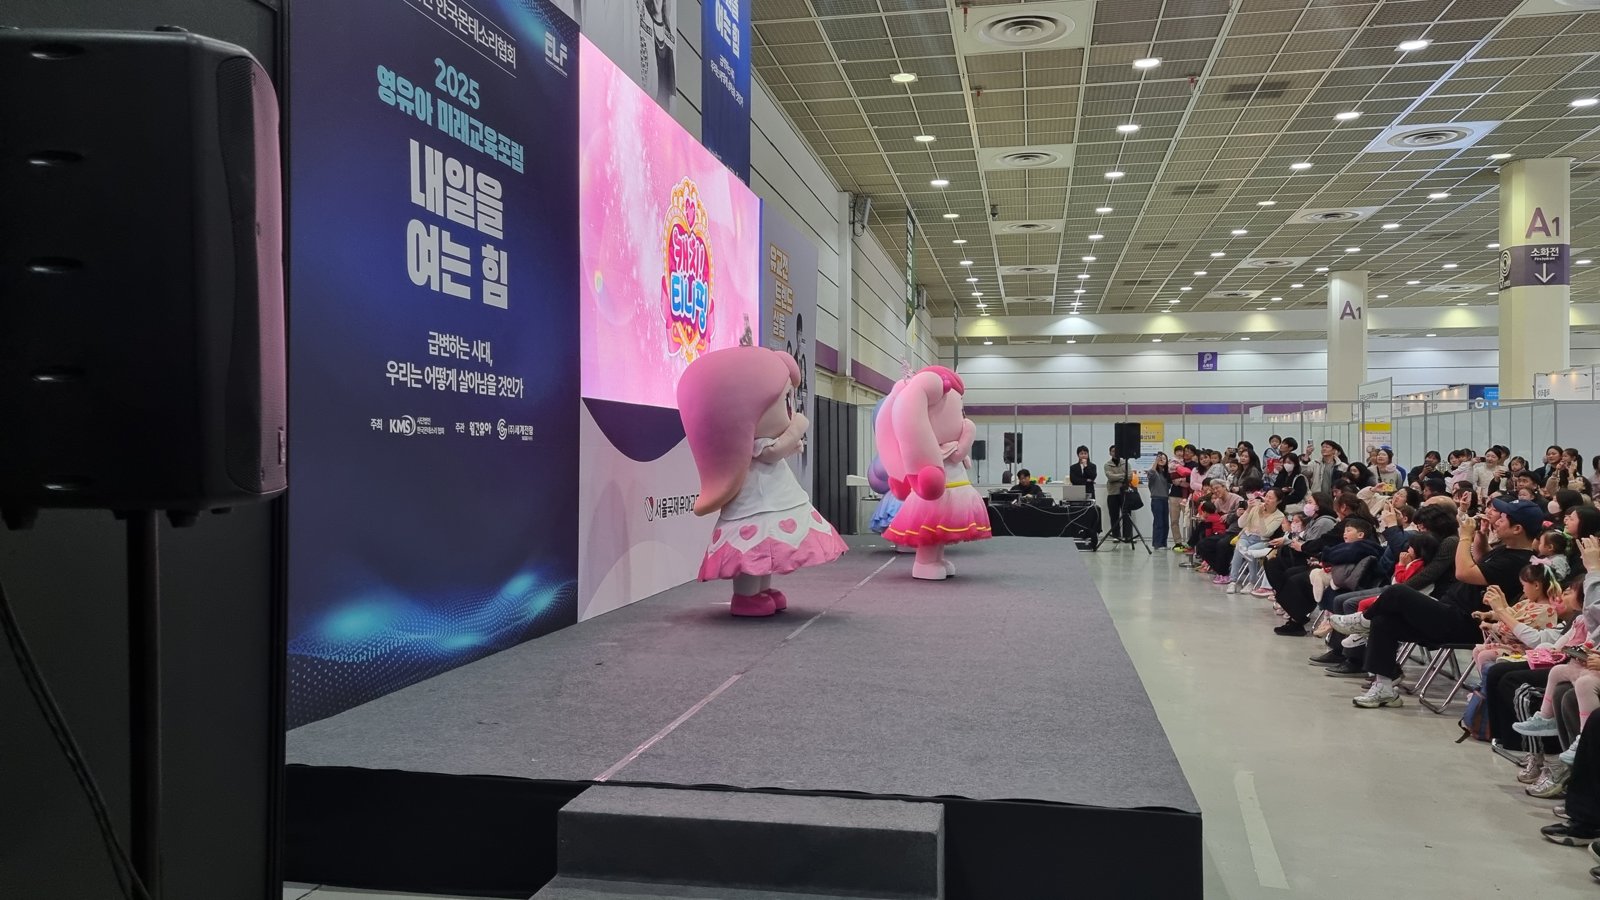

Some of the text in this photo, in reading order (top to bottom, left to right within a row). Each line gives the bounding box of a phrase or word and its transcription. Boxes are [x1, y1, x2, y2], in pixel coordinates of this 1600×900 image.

[544, 31, 568, 67] ELF
[434, 57, 480, 110] 2025
[377, 64, 525, 174] 영유아 미래교육포럼
[409, 138, 504, 240] 내일을
[1525, 207, 1560, 239] A1
[406, 218, 508, 310] 여는 힘
[1530, 247, 1559, 257] 소화전
[671, 272, 709, 333] 티니핑
[1340, 301, 1361, 320] A1
[428, 331, 493, 367] 급변하는 시대,
[386, 360, 524, 399] 우리는 어떻게 살아남을 것인가
[370, 418, 412, 434] 주최 KMS
[455, 422, 465, 433] 주관
[469, 421, 492, 436] 월간유아
